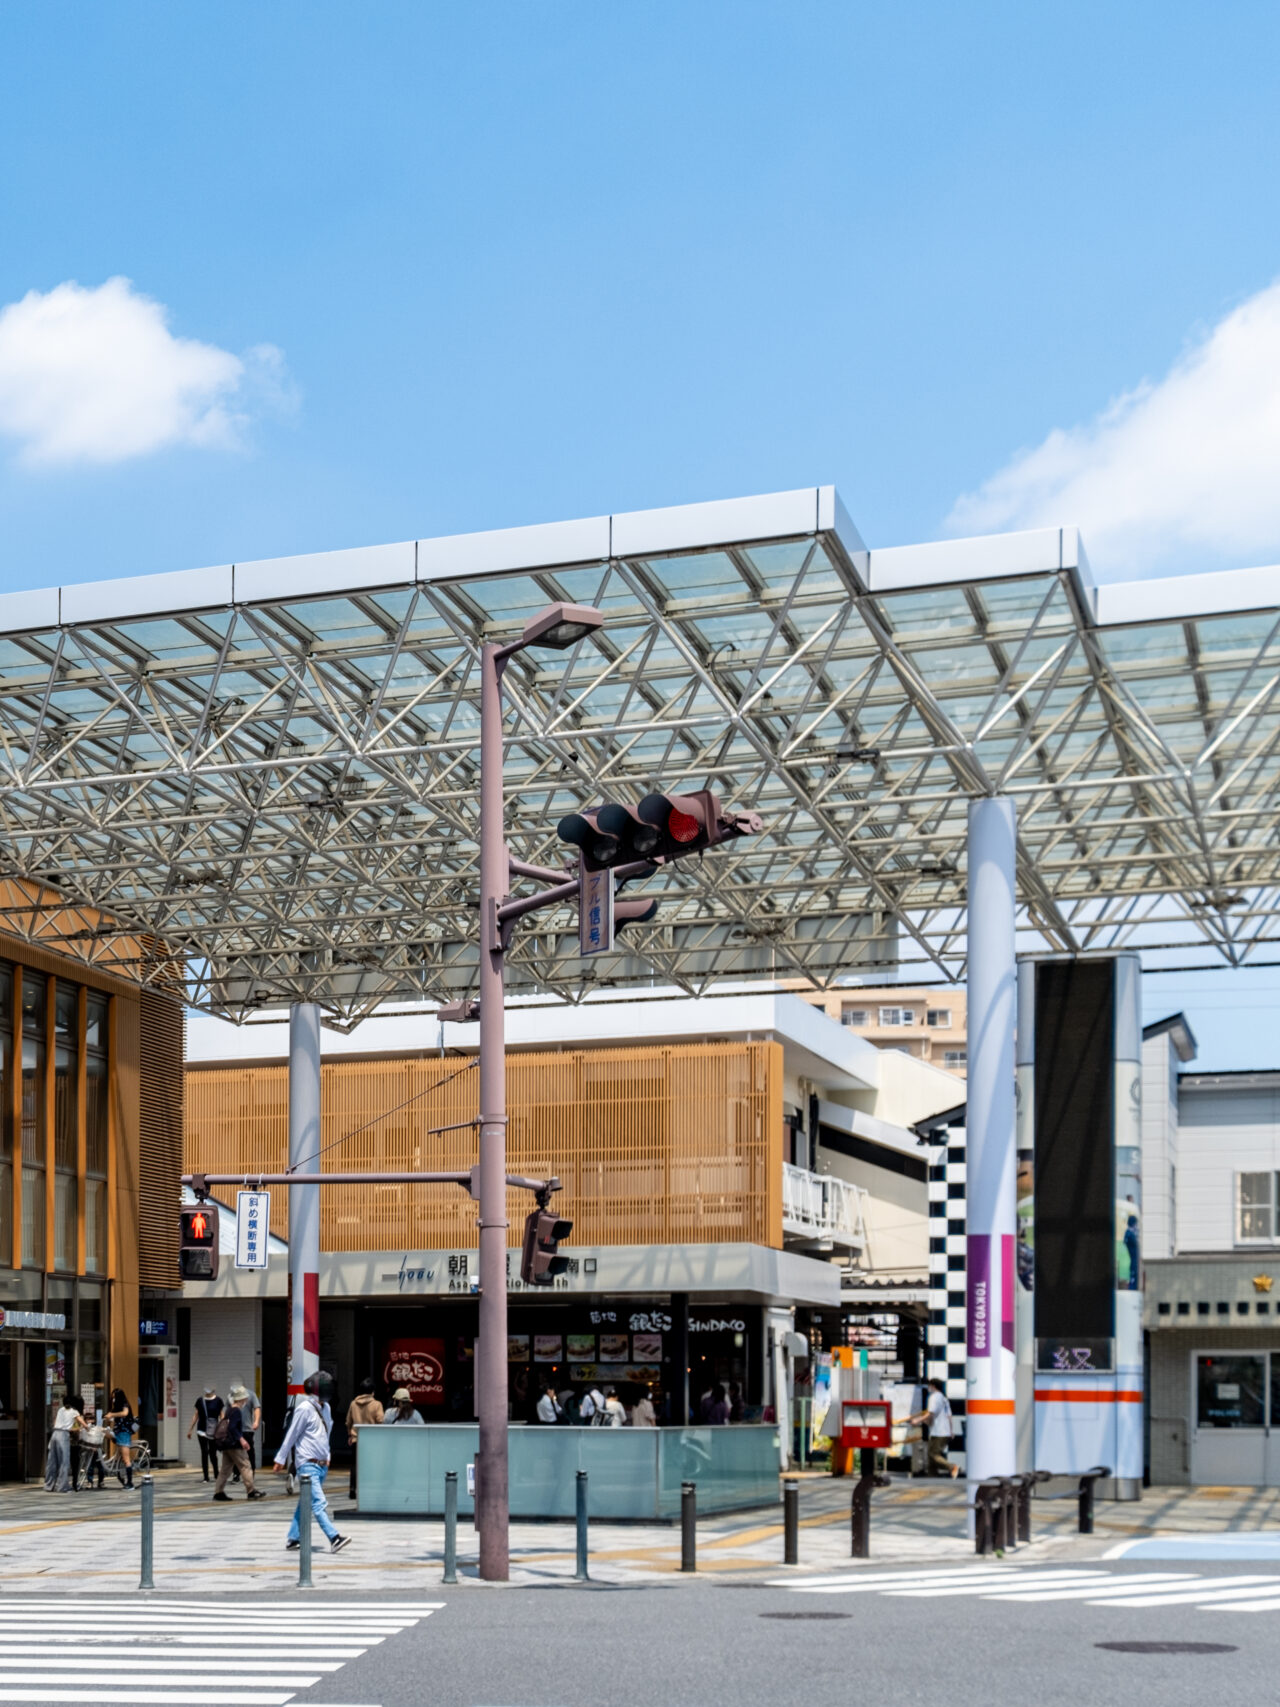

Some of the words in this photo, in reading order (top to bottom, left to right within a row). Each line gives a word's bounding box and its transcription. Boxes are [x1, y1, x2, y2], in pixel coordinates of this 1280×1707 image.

[247, 1197, 259, 1263] 斜め横断専用
[975, 1282, 986, 1319] TOKYO
[629, 1310, 672, 1332] 銀だこ
[975, 1321, 986, 1349] 2020
[391, 1360, 433, 1382] 銀だこ
